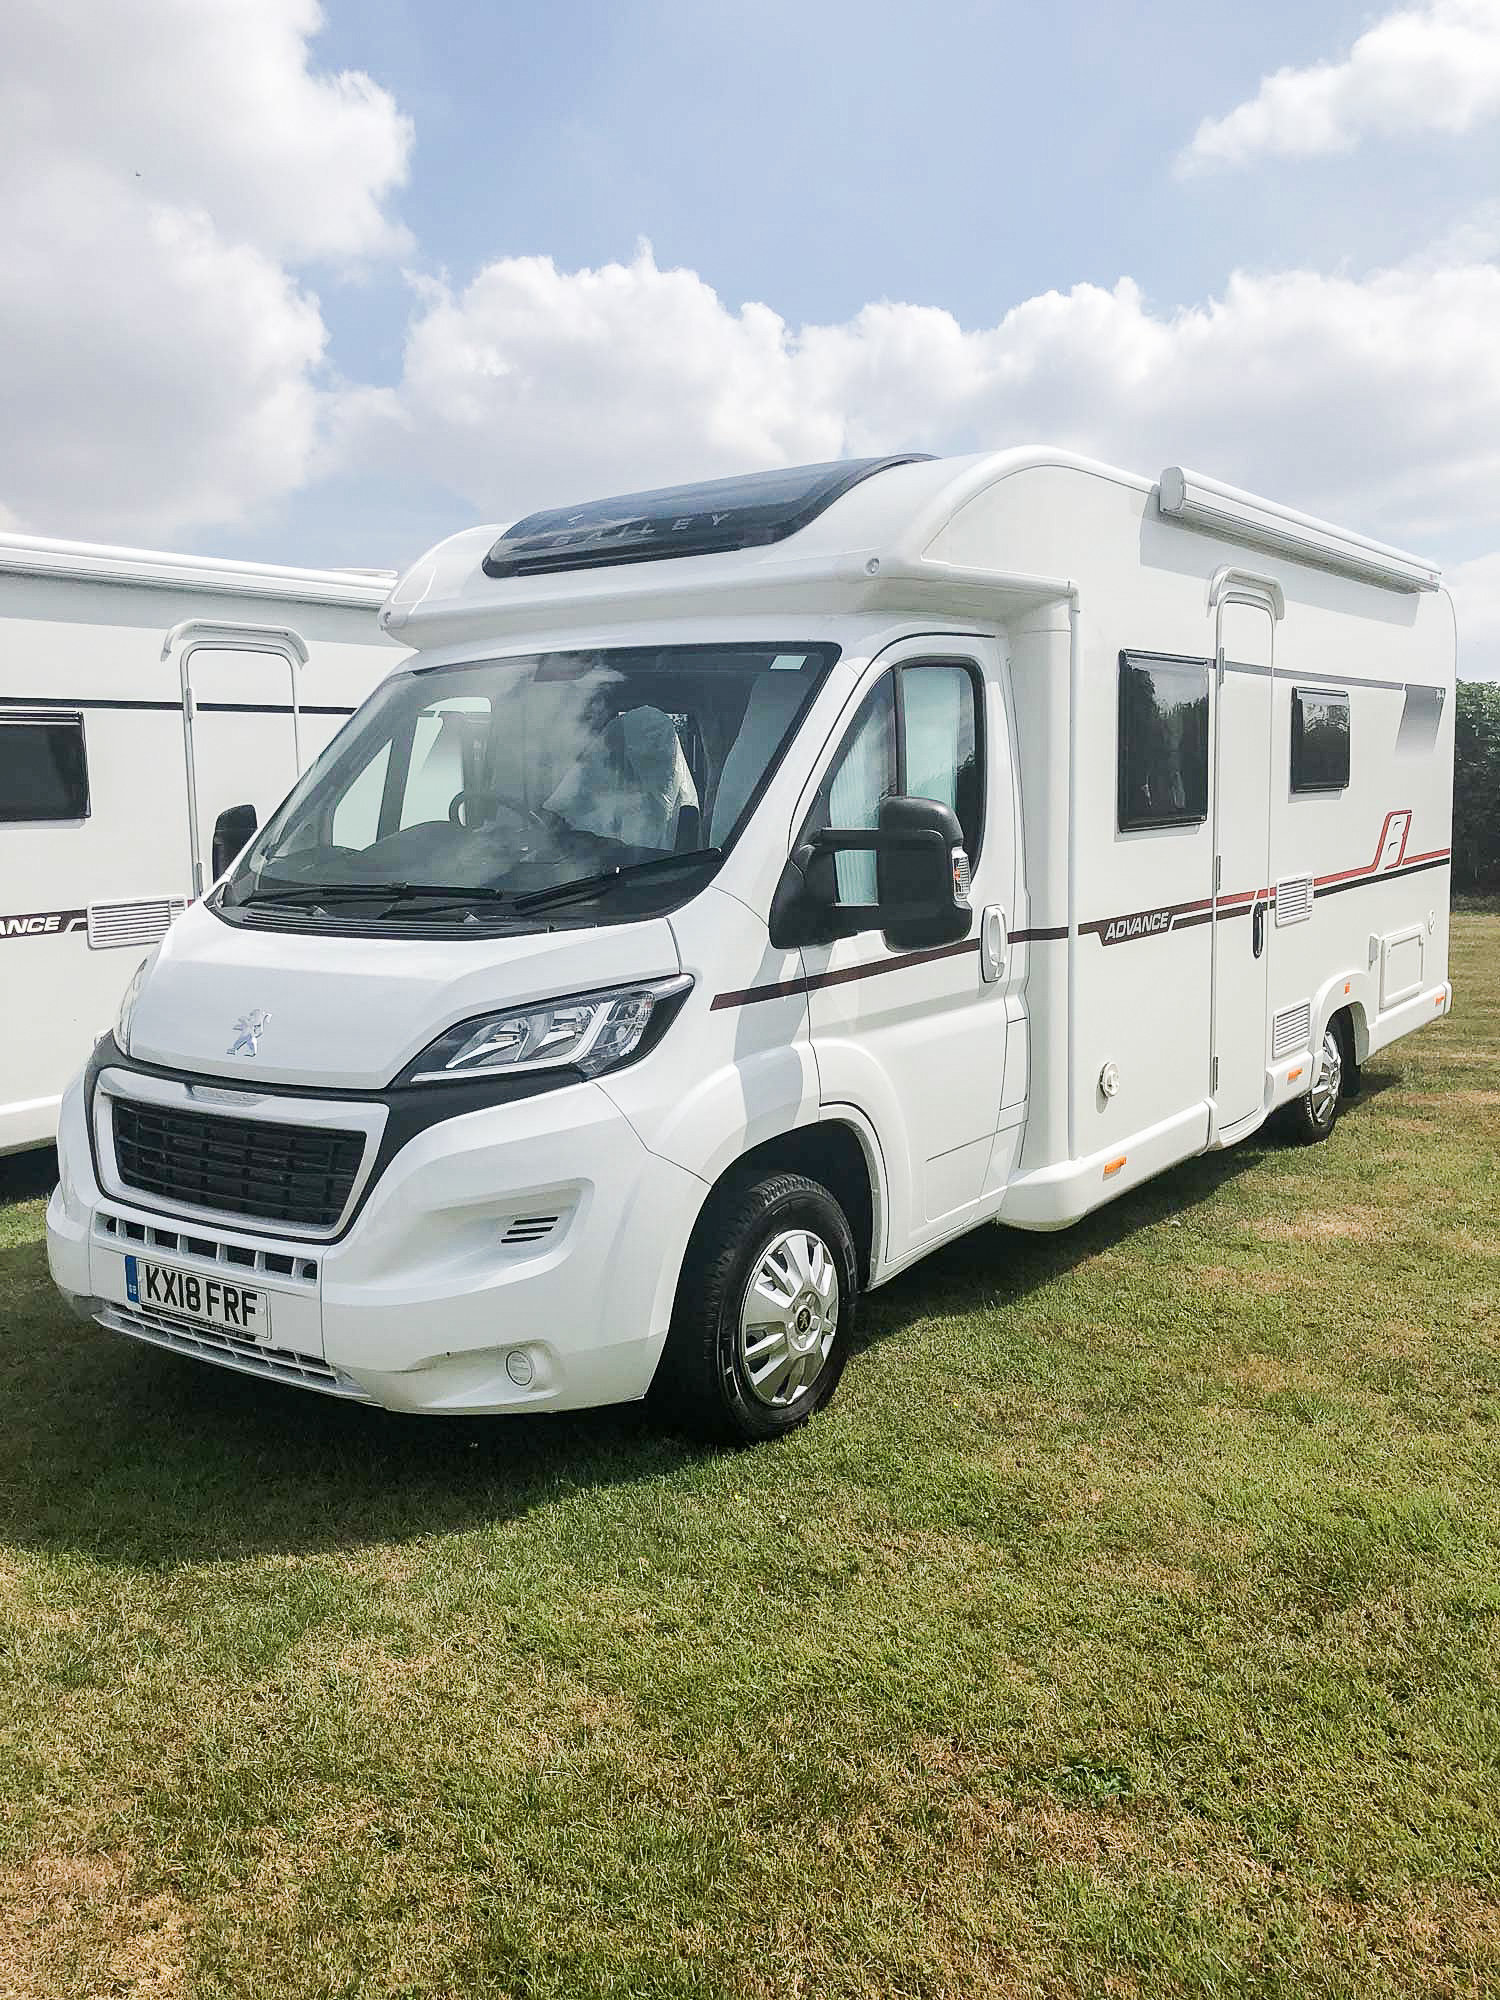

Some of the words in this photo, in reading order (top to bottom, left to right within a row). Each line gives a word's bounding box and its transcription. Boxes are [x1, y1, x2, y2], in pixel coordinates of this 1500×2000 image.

[1104, 911, 1170, 941] ADVANCE
[145, 1265, 200, 1311] KX18
[205, 1280, 258, 1327] FRF
